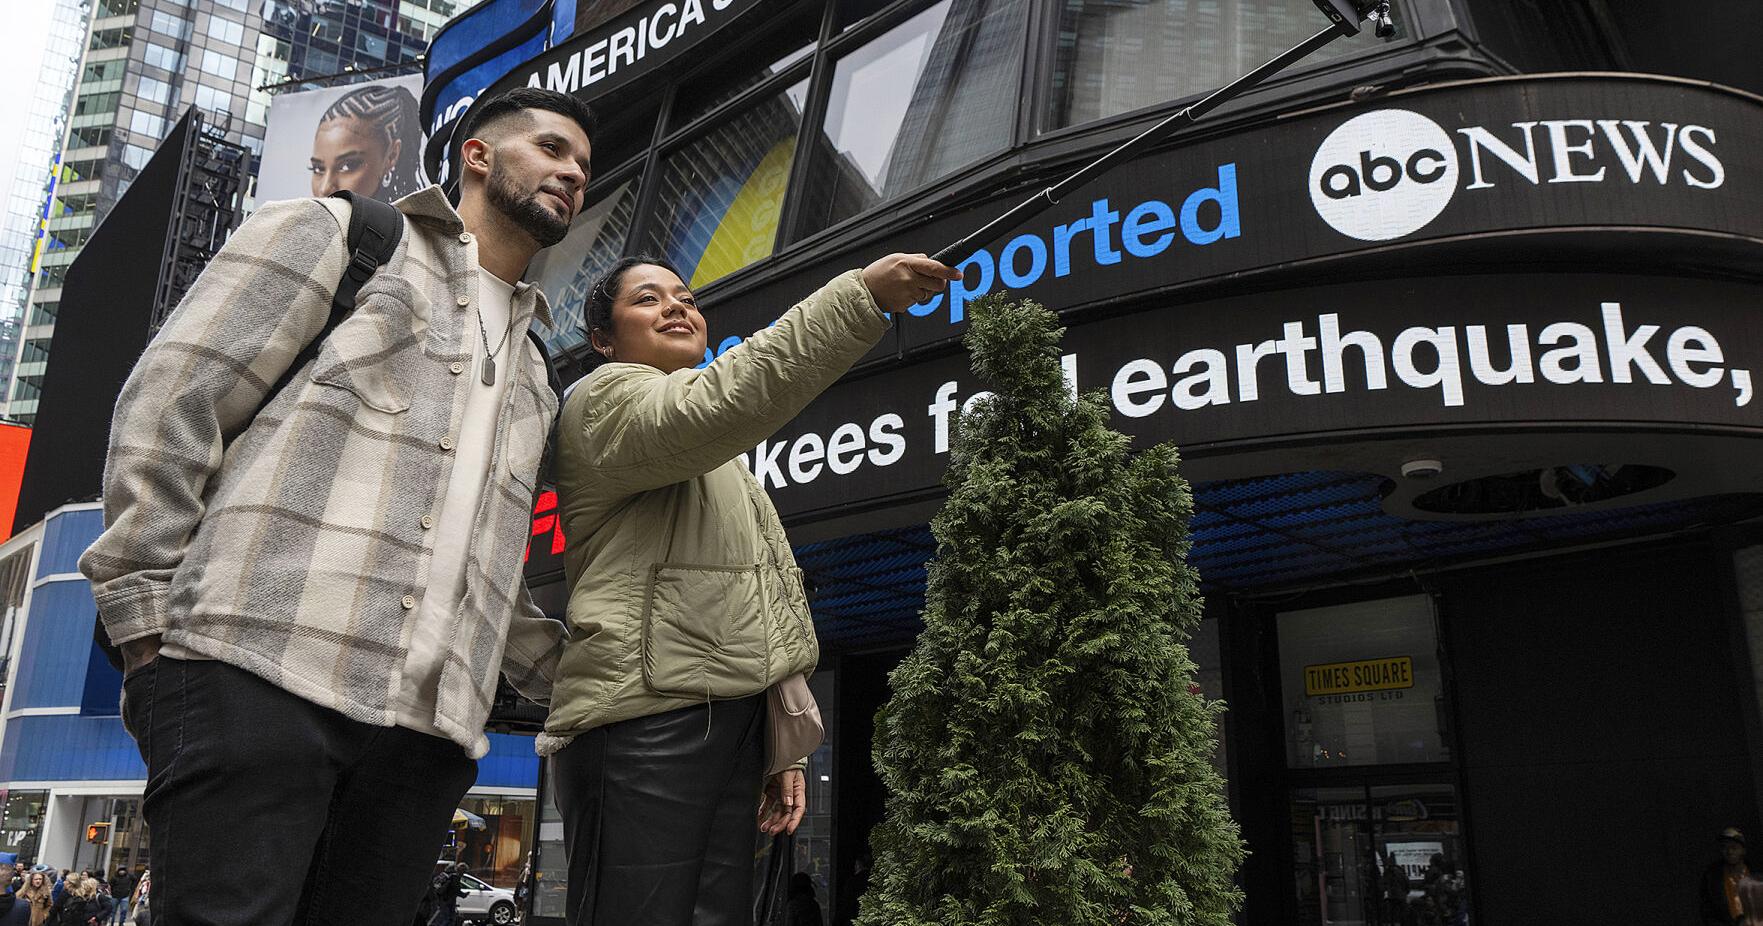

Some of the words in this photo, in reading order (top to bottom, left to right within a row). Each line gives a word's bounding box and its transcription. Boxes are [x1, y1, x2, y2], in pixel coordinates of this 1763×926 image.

[1320, 148, 1447, 200] abc
[1457, 119, 1725, 190] NEWS
[883, 162, 1241, 324] ported
[742, 412, 906, 489] kees
[928, 353, 1078, 454] fl
[1111, 302, 1753, 418] earthquake,
[1309, 667, 1350, 690] TIMES
[1354, 661, 1409, 687] SQUARE
[1319, 692, 1375, 705] STUDIOS
[1380, 690, 1404, 700] LTD
